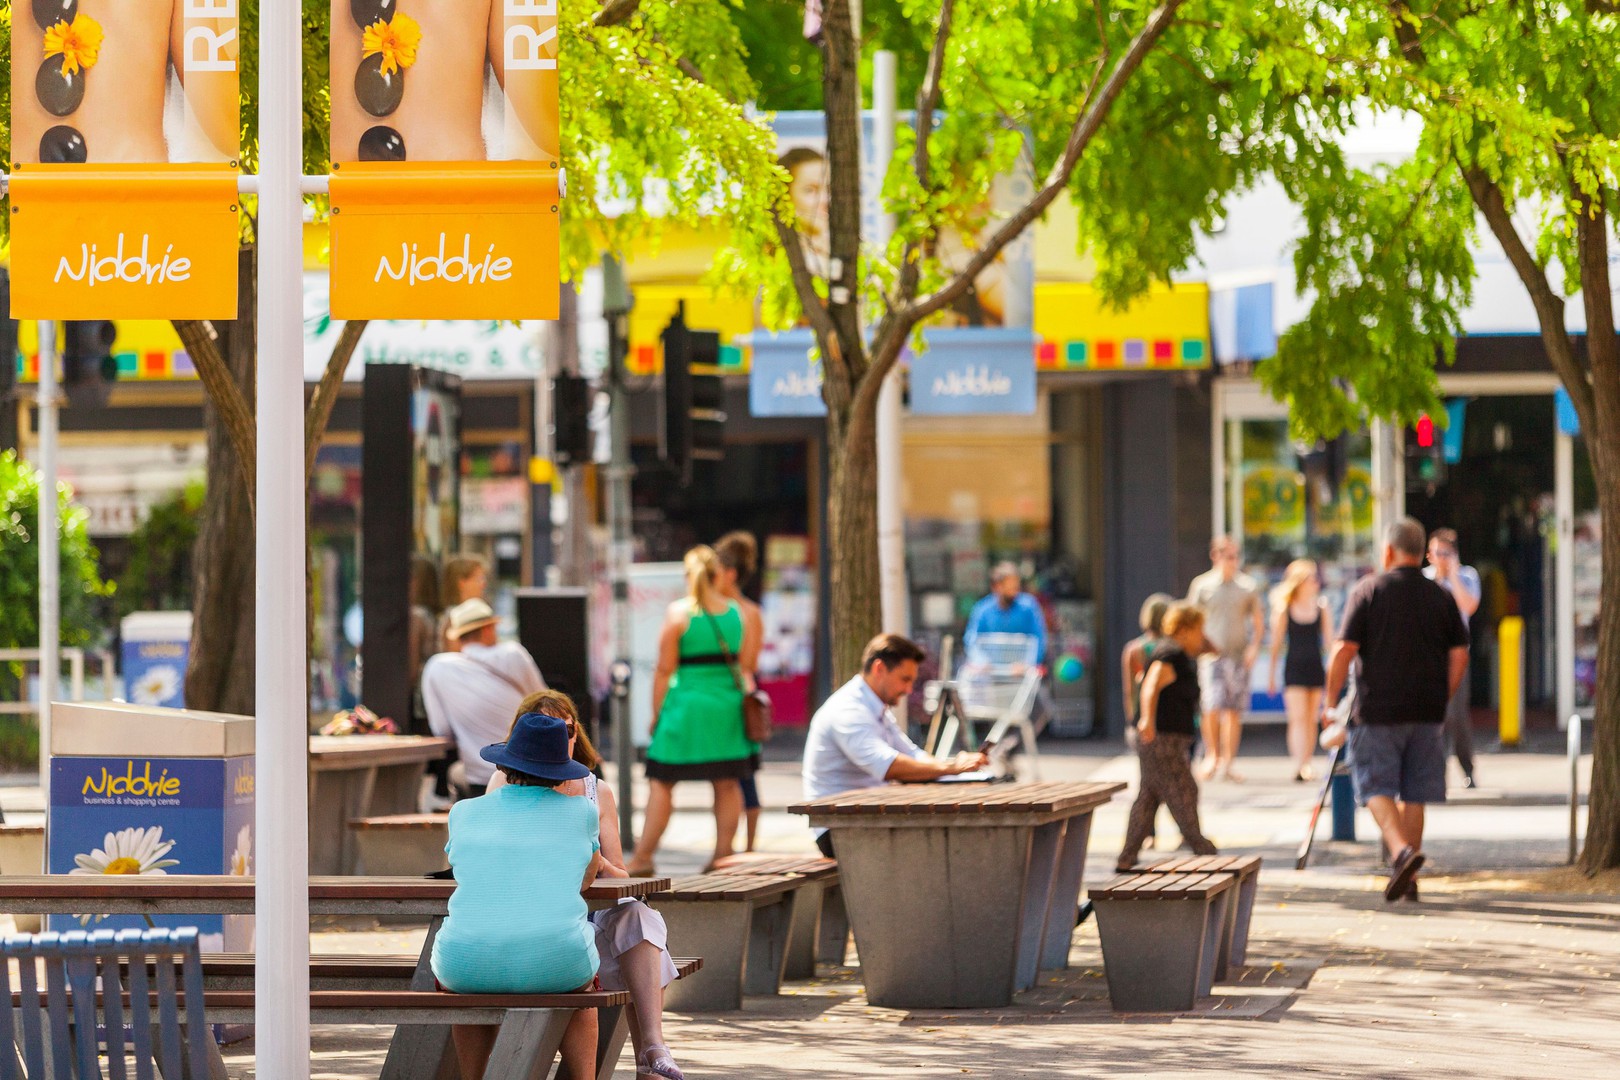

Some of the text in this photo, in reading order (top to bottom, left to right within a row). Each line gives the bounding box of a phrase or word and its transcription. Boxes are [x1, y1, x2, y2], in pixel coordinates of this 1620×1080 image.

[53, 232, 191, 287] Niddrie
[374, 232, 513, 286] Niddrie
[81, 760, 180, 798] Niddrie
[83, 796, 181, 807] business & shopping centre
